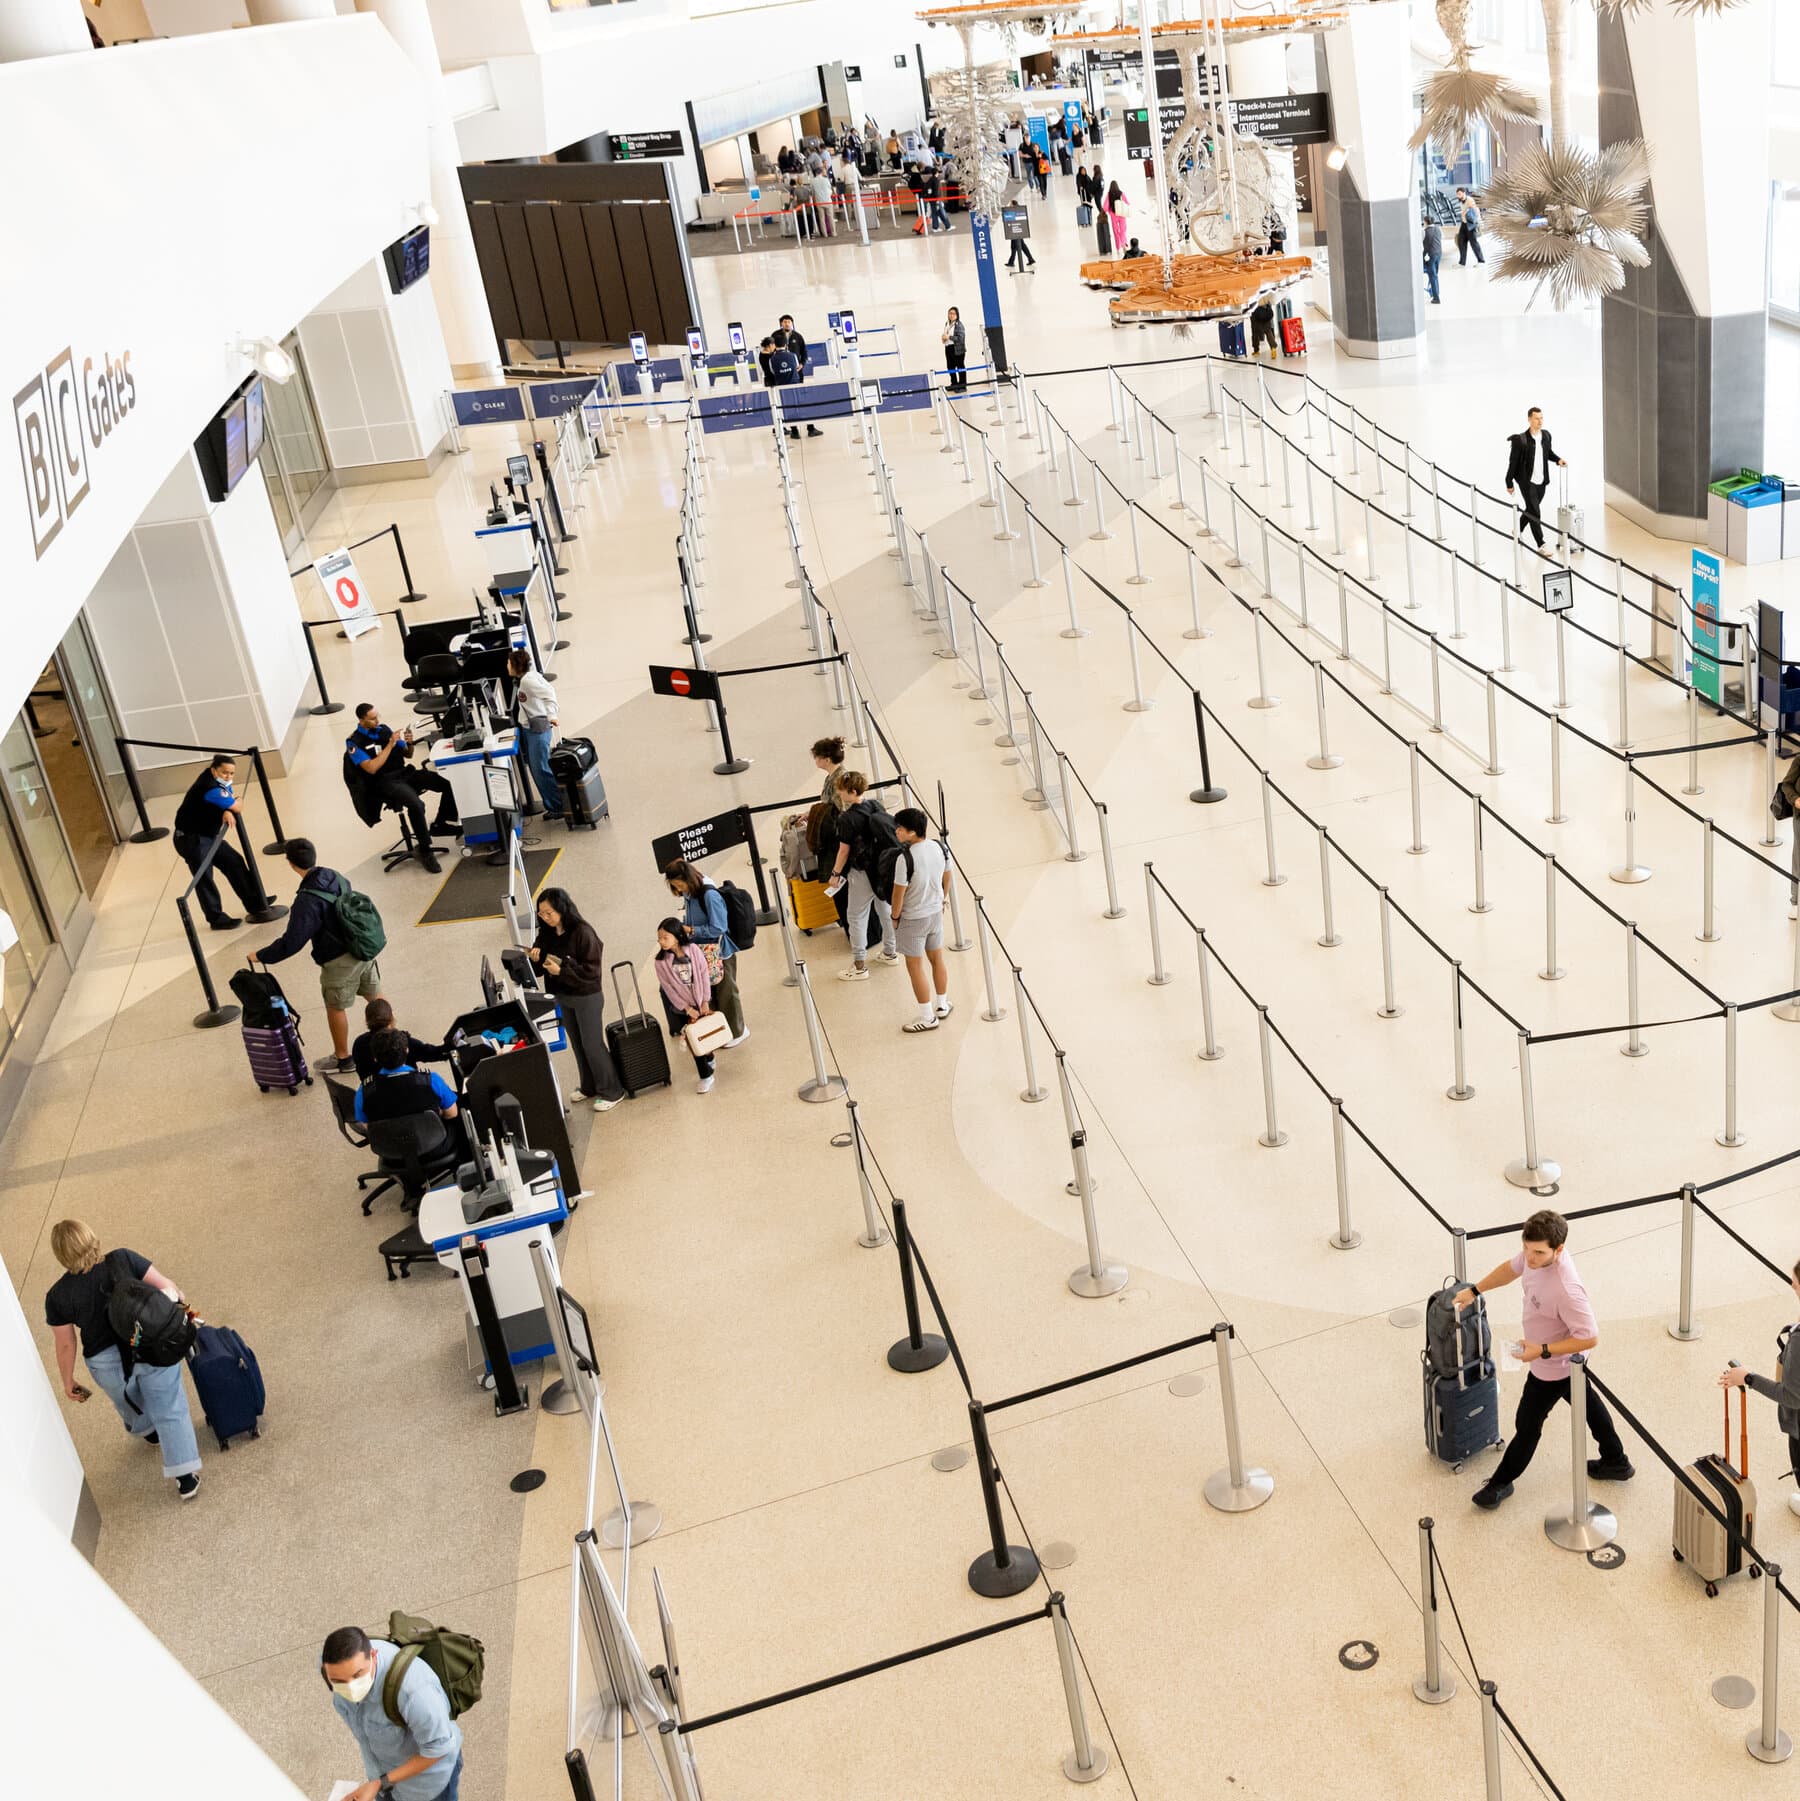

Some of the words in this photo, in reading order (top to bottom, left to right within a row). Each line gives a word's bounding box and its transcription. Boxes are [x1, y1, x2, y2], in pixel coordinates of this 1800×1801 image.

[1159, 109, 1185, 118] AirTrain
[1239, 101, 1266, 111] Check-in
[1239, 111, 1282, 122] International
[1282, 108, 1311, 118] Terminal
[1259, 122, 1279, 131] Gates
[978, 231, 988, 260] CLEAR
[484, 401, 505, 409] CLEAR
[25, 411, 51, 519] B
[58, 379, 80, 477] C
[83, 349, 136, 449] Gates
[1696, 559, 1711, 574] Have
[678, 823, 714, 842] Please
[680, 836, 704, 852] Wait
[682, 847, 708, 862] Here
